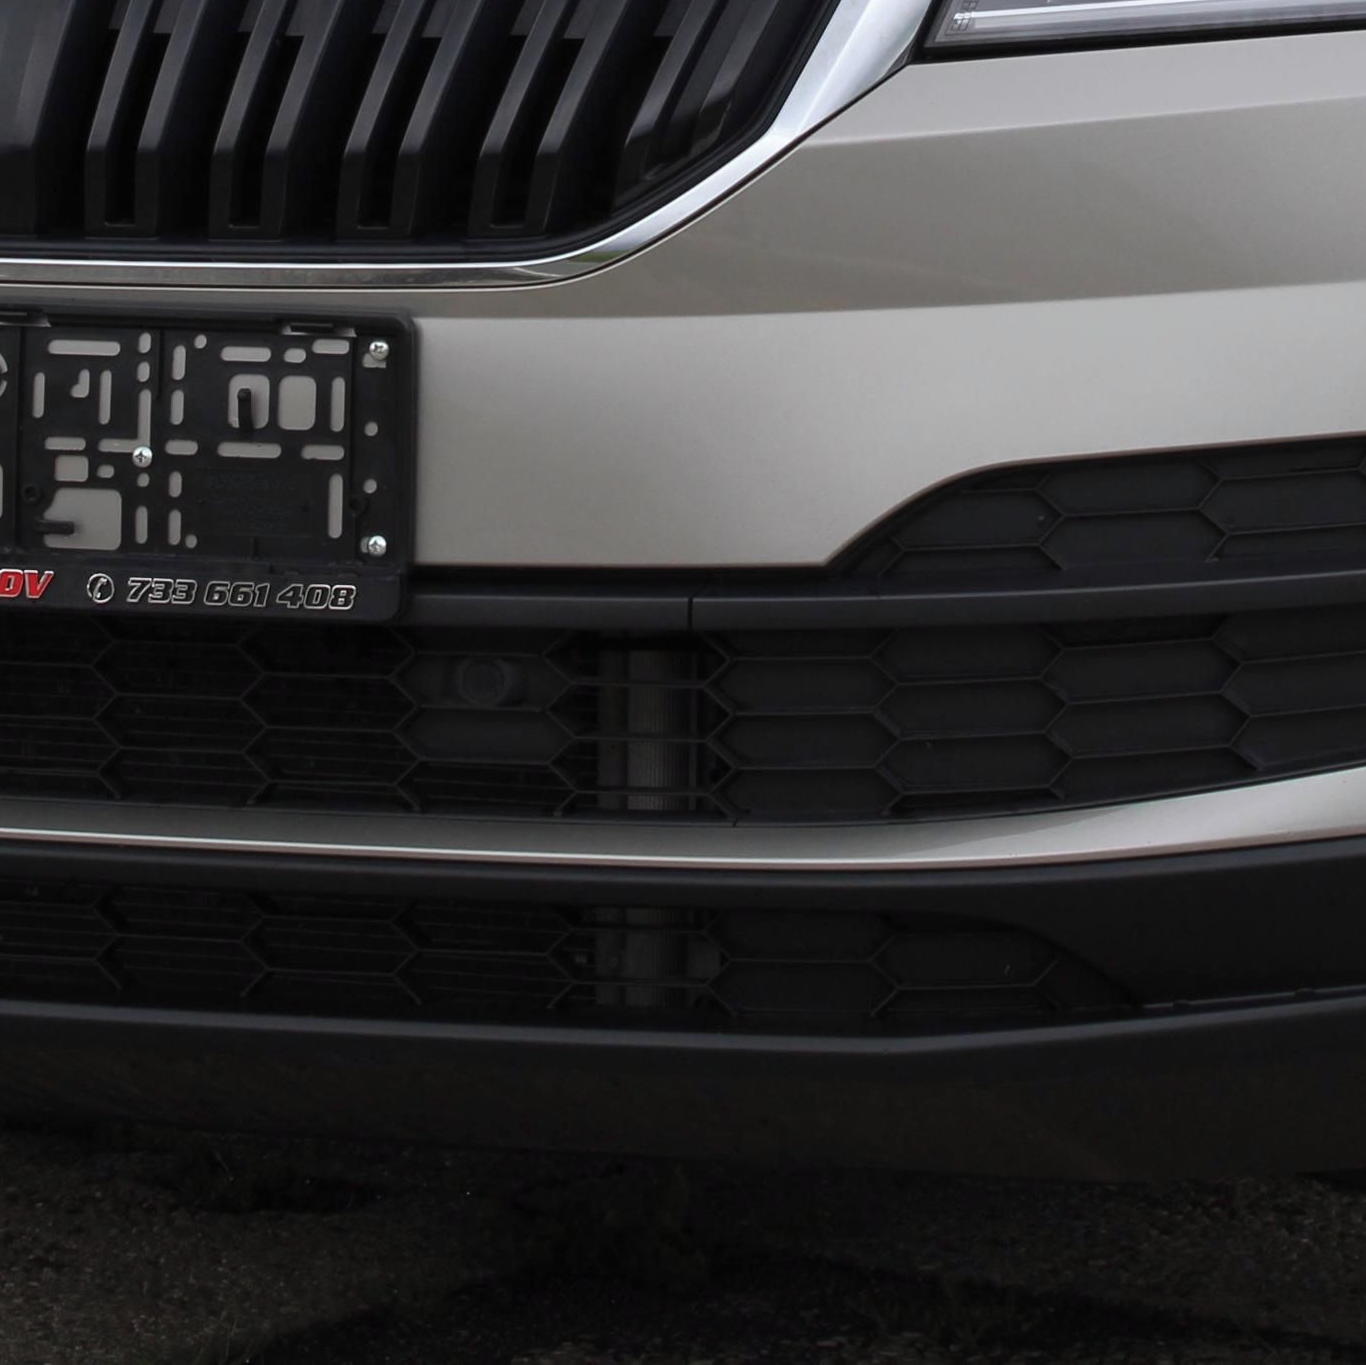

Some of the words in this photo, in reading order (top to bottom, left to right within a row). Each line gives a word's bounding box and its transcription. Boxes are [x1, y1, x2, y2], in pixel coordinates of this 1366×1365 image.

[126, 577, 198, 605] 733
[203, 580, 271, 608] 661
[276, 584, 357, 610] 408
